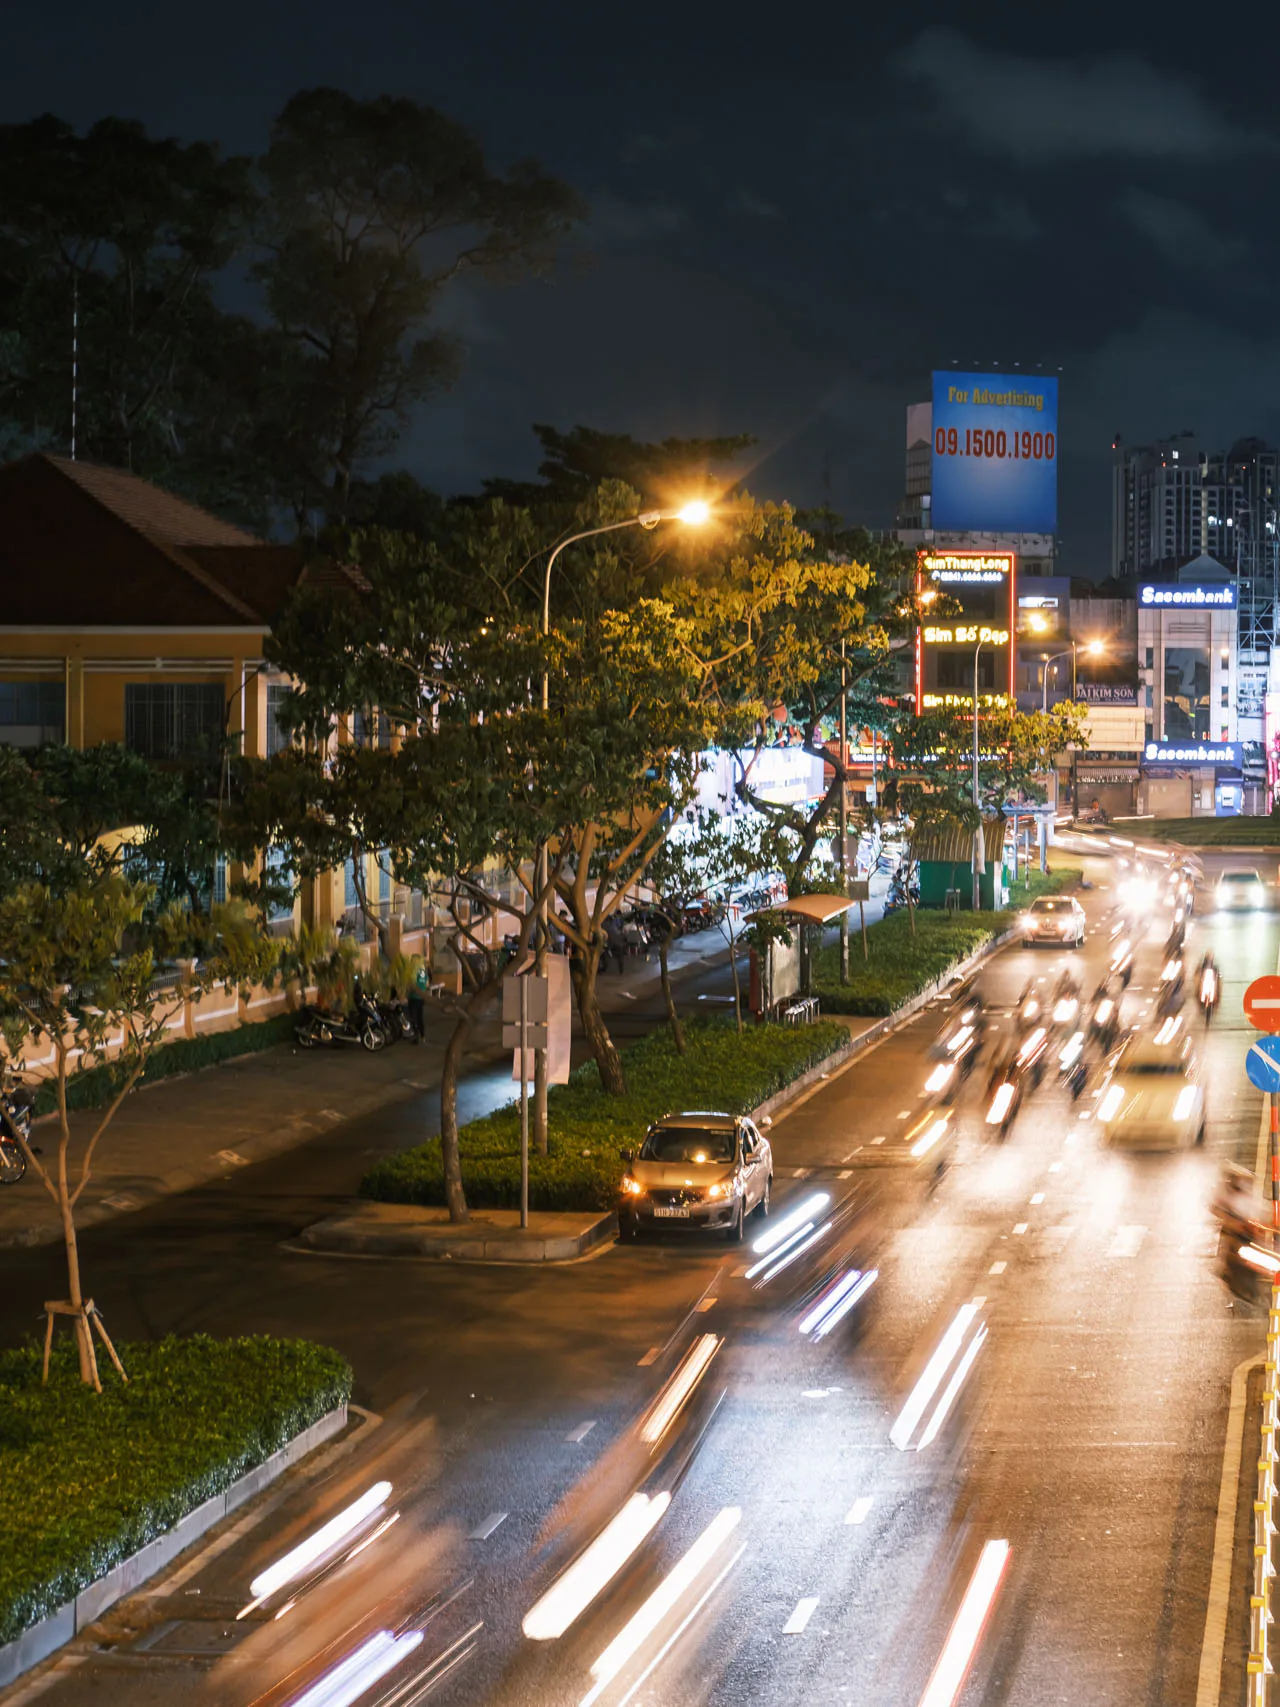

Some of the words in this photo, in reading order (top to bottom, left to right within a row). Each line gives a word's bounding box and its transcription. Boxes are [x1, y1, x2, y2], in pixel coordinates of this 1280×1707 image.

[948, 386, 969, 403] For
[972, 388, 1044, 411] Advertising
[935, 427, 1055, 460] 09.1500.1900
[1142, 586, 1233, 603] Sacombank
[924, 627, 952, 642] Sim
[1146, 744, 1234, 760] Sacombank
